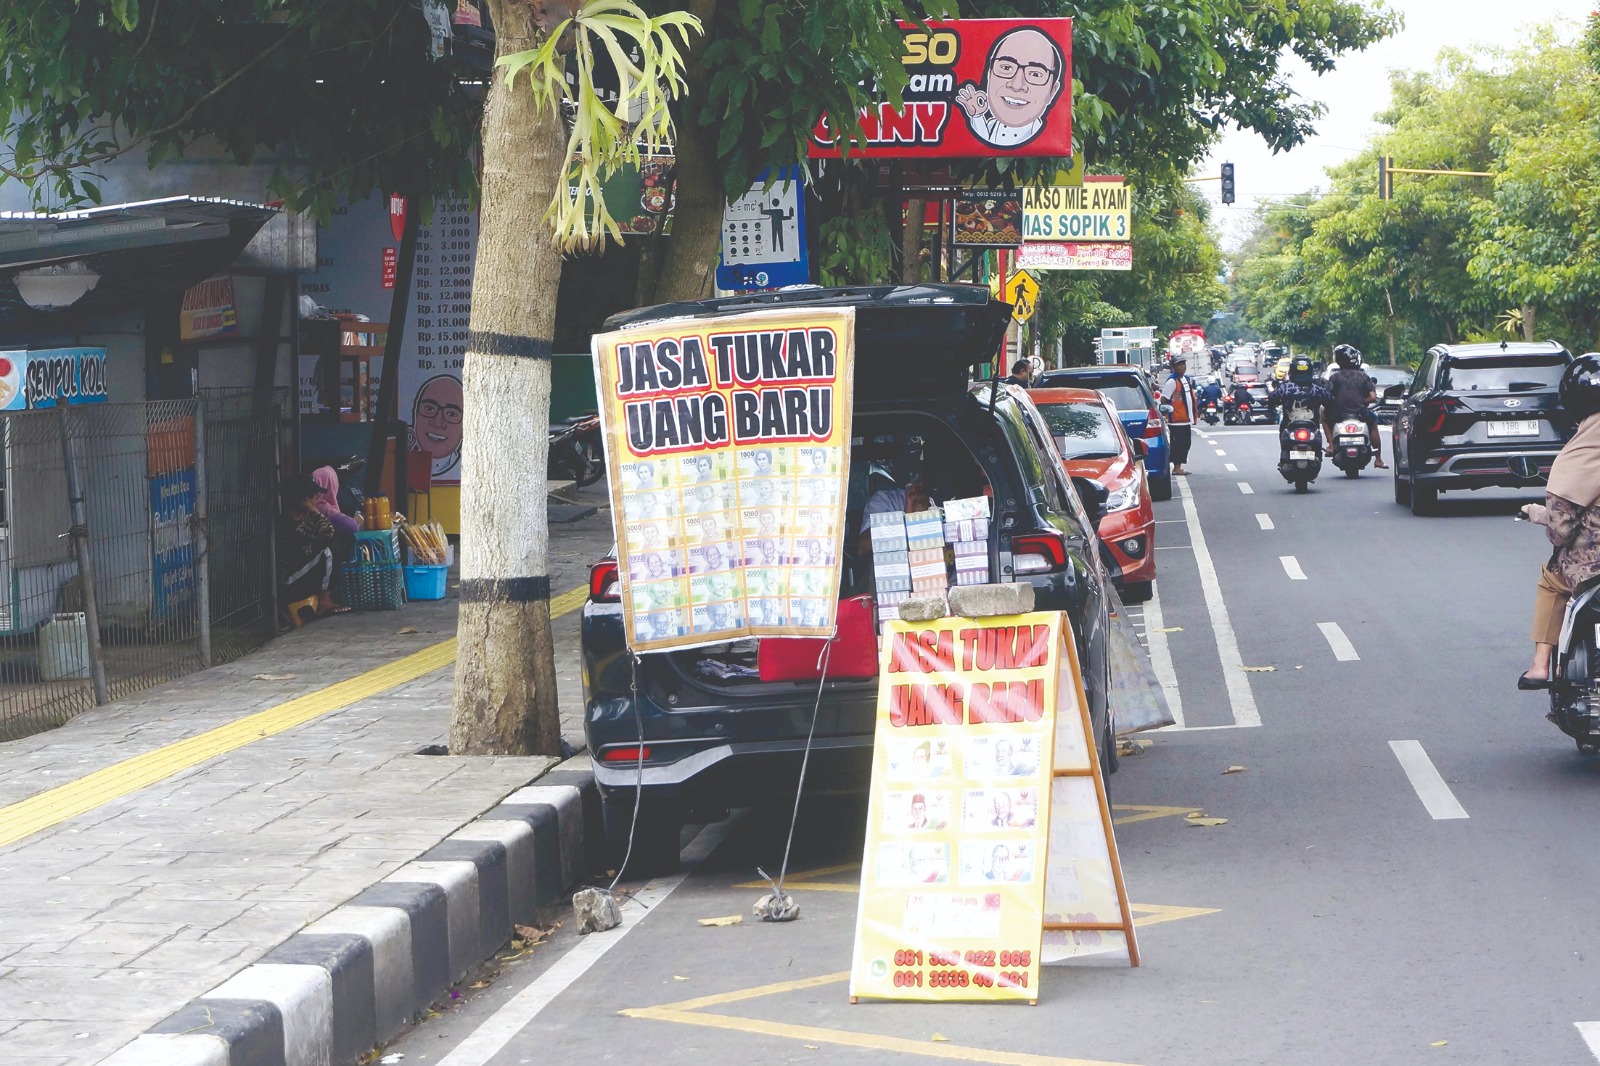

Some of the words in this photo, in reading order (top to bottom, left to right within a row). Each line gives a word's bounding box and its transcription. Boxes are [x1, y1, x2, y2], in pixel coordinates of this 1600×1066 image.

[1065, 188, 1088, 209] MIE
[1092, 188, 1127, 209] AYAM
[440, 217, 470, 225] 2.000
[1058, 214, 1110, 236] SOPIK
[1116, 214, 1125, 236] 3
[441, 229, 470, 237] 1.000
[440, 242, 470, 250] 3.000
[1024, 245, 1045, 254] BAKSO
[416, 255, 433, 263] Rp.
[441, 254, 470, 262] 6.000
[1019, 255, 1050, 266] SPESIAL
[1053, 256, 1073, 266] KEJU
[416, 267, 432, 276] Rp.
[439, 267, 470, 275] 12.000
[417, 280, 432, 288] Rp.
[440, 280, 470, 288] 12.000
[417, 292, 432, 301] Rp.
[440, 292, 471, 300] 12.000
[417, 305, 434, 314] Rp.
[437, 304, 471, 313] 17.000
[417, 319, 434, 328] Rp.
[437, 318, 470, 327] 18.000
[418, 332, 434, 342] Rp.
[418, 346, 434, 355] Rp.
[438, 345, 465, 354] 10.00
[418, 359, 435, 369] Rp.
[618, 337, 708, 394] JASA
[711, 329, 835, 384] TUKAR
[27, 357, 78, 401] SEMPOL
[627, 394, 728, 450] UANG
[735, 388, 831, 438] BARU
[1489, 421, 1495, 430] N
[743, 510, 759, 518] 5000
[888, 629, 955, 674] JASA
[960, 624, 1050, 672] TUKAR
[889, 682, 964, 727] UANG
[968, 678, 1044, 724] BARU
[894, 949, 924, 967] 081
[1000, 950, 1031, 967] 965
[893, 970, 924, 988] 081
[928, 970, 970, 988] 3333
